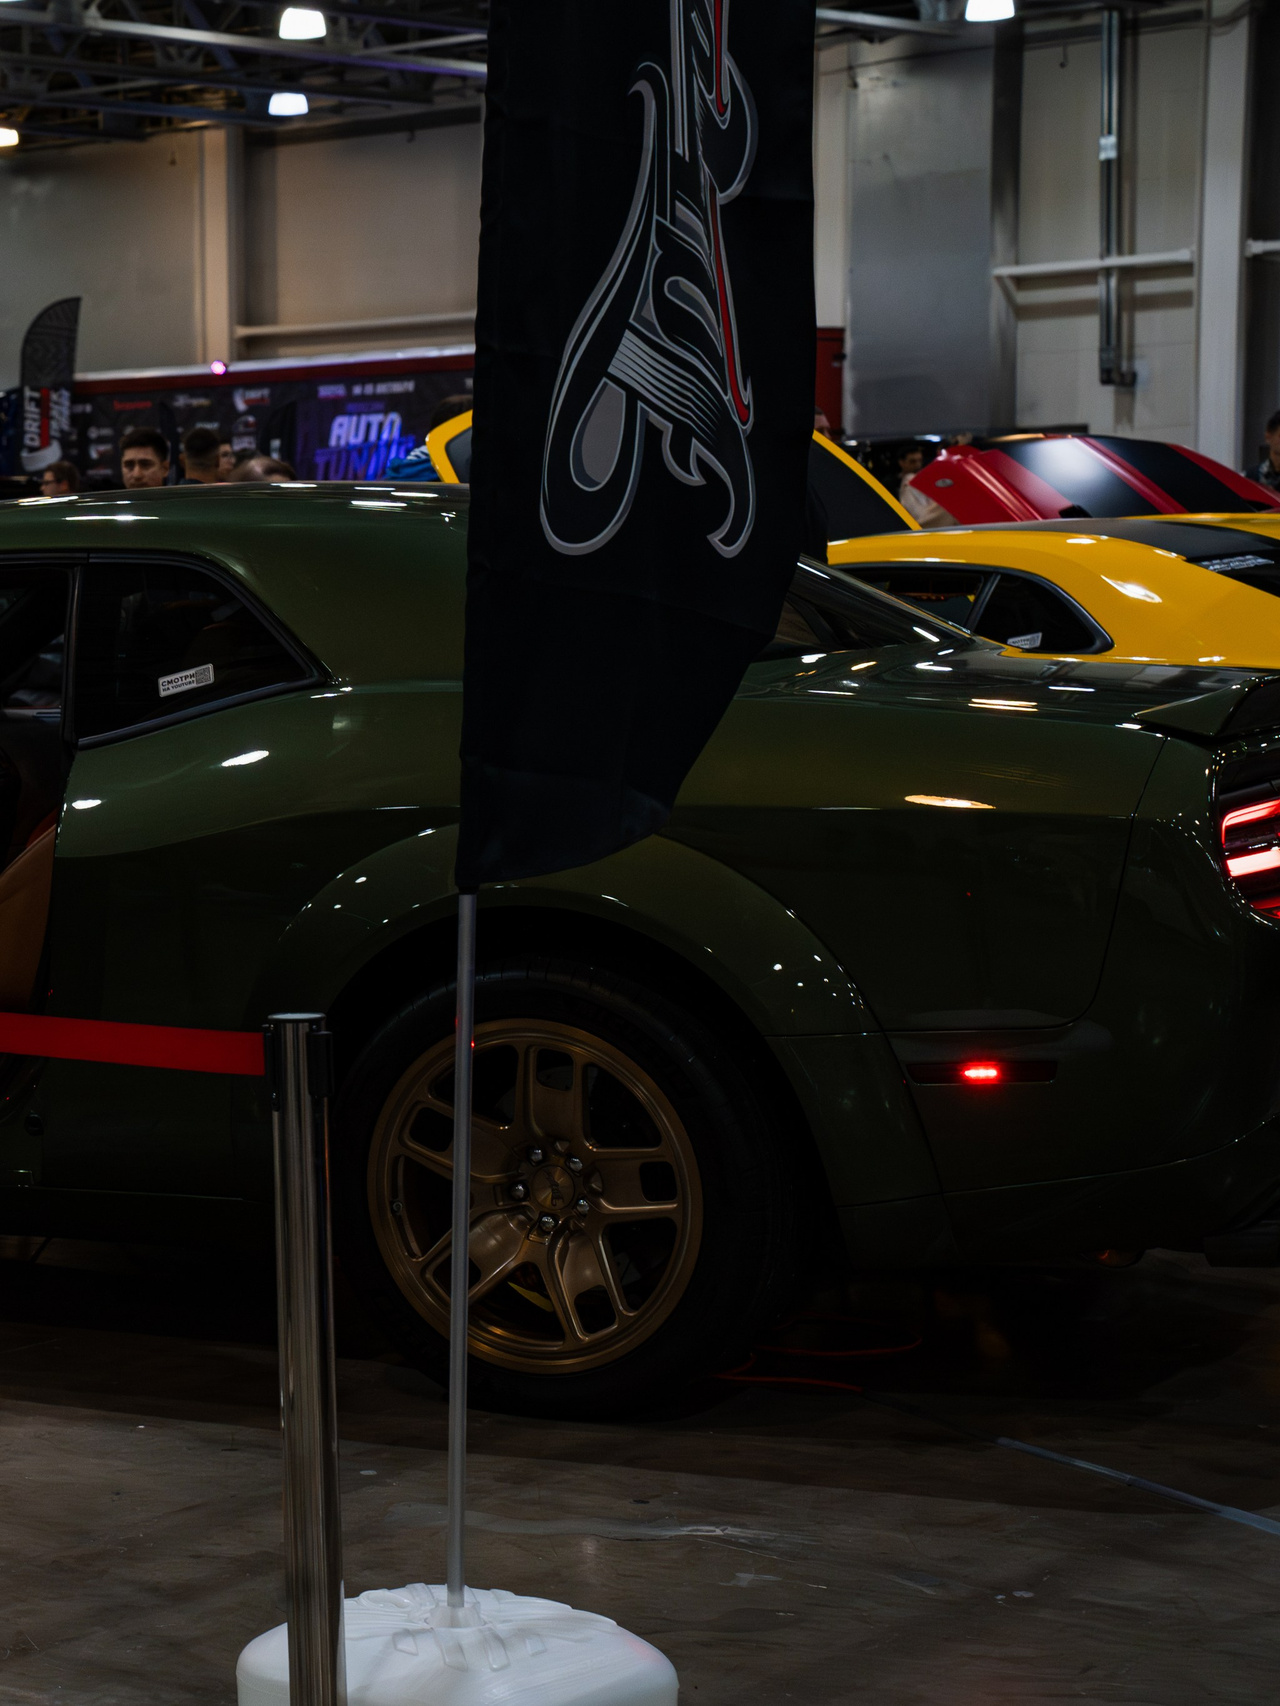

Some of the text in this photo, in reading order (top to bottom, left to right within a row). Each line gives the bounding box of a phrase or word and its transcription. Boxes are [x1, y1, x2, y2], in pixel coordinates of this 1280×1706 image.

[23, 385, 41, 448] DRIFT
[328, 411, 403, 448] AUTO
[161, 672, 195, 687] СМОТРИ
